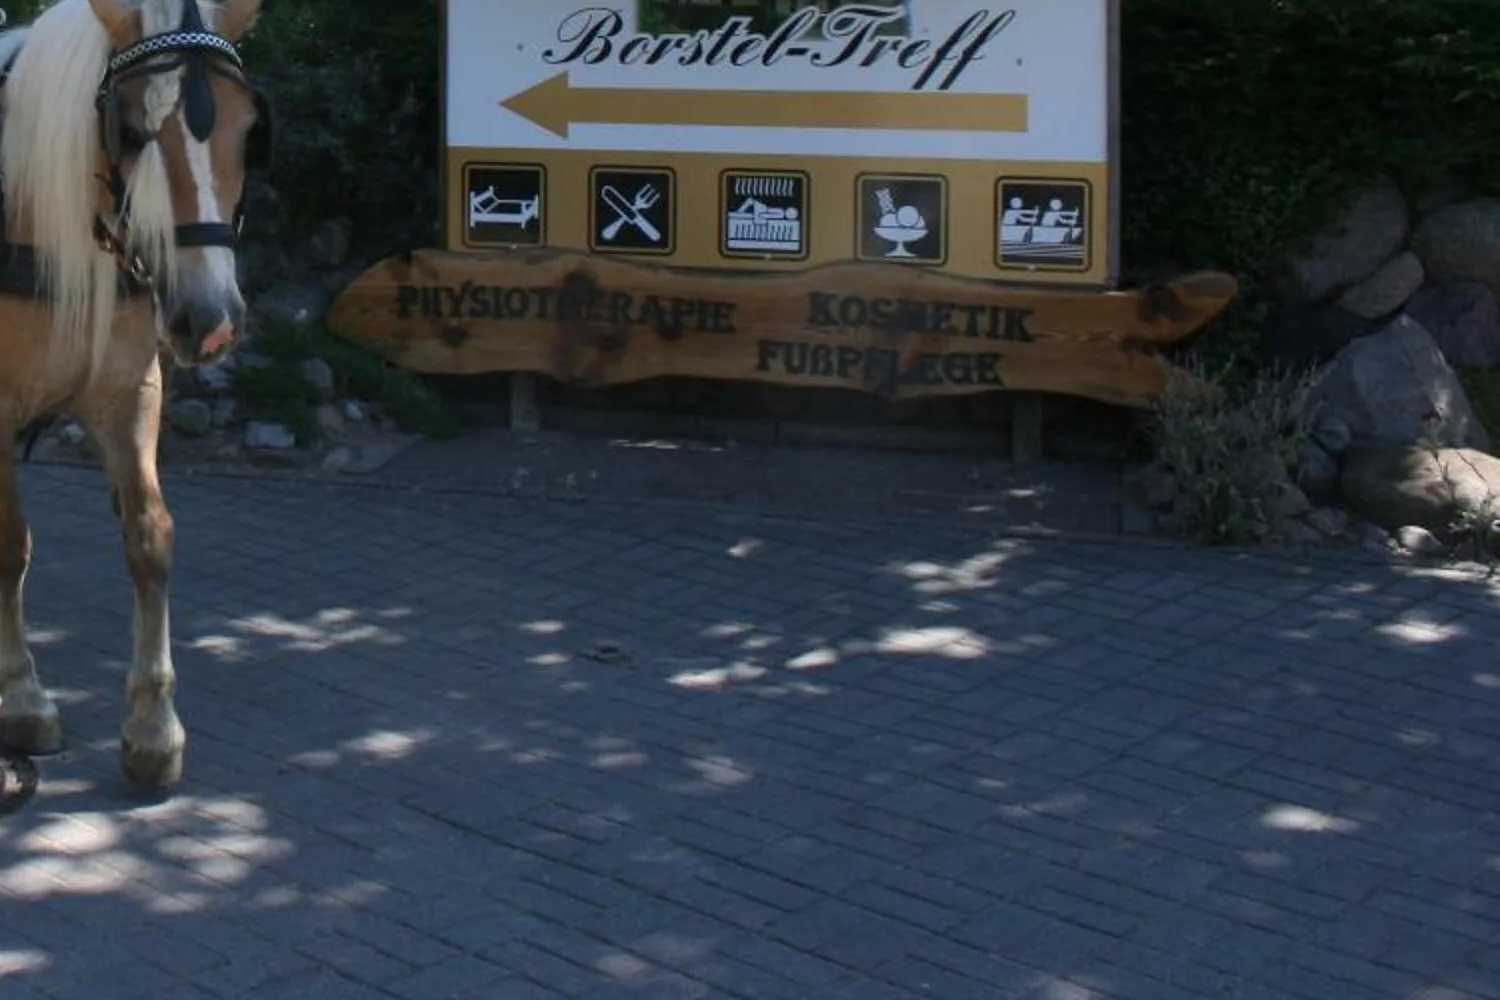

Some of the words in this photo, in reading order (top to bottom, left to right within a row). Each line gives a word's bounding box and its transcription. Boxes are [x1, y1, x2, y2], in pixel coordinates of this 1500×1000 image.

[541, 4, 1018, 91] Borstel-Treff
[395, 280, 738, 334] PHYSIOTHERAPIE
[807, 291, 1036, 342] KOSMETIK
